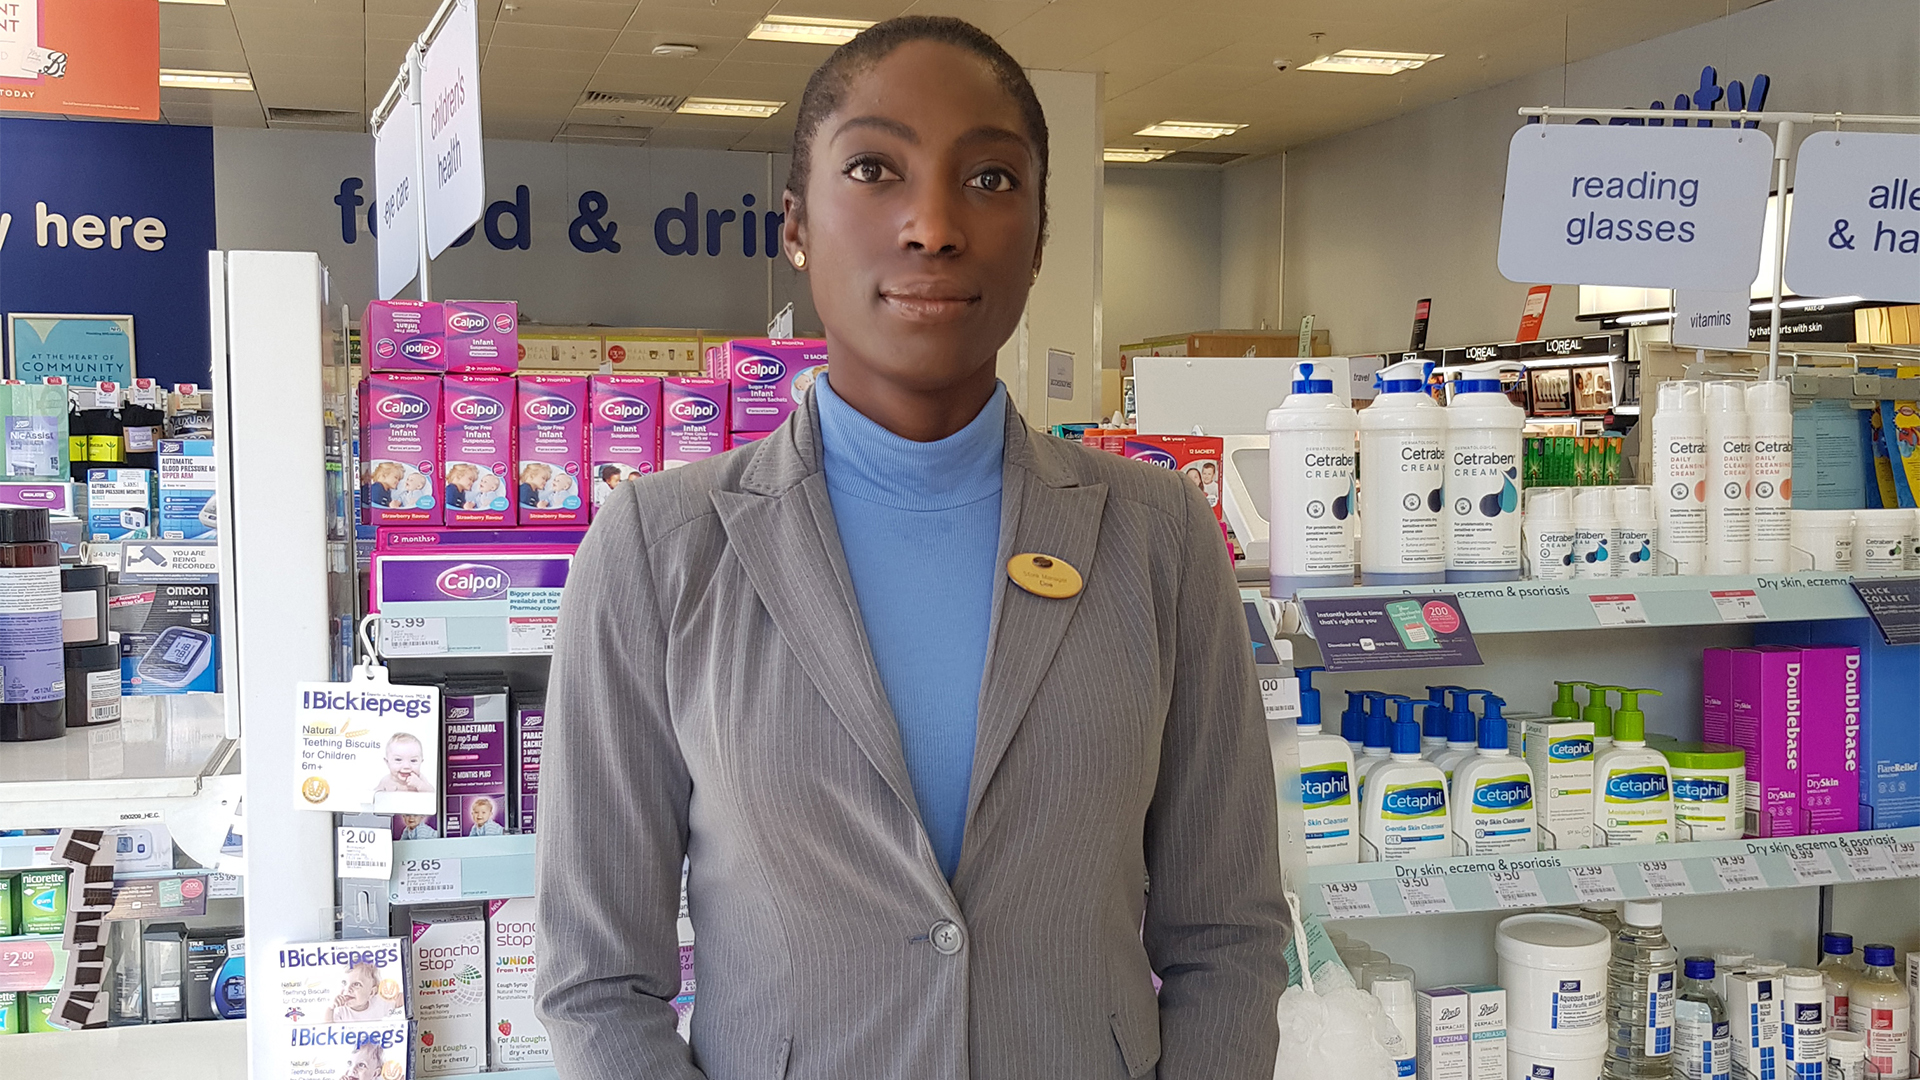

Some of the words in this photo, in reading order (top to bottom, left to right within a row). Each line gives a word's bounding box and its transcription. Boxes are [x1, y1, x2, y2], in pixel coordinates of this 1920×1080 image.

[430, 68, 466, 141] children's
[437, 133, 462, 190] health
[1571, 171, 1699, 208] reading
[383, 193, 395, 230] eye
[395, 176, 410, 207] care
[334, 177, 531, 251] fd
[568, 190, 622, 254] &
[654, 191, 785, 258] dri
[35, 201, 167, 251] here
[1565, 211, 1696, 246] glasses
[1828, 219, 1855, 250] &
[453, 317, 486, 329] Calpol
[1690, 310, 1731, 329] vitamins
[1757, 326, 1771, 337] that
[1793, 324, 1807, 334] with
[1808, 323, 1823, 333] skin
[405, 344, 437, 356] Calpol
[1546, 339, 1581, 353] L'ORÉAL
[1465, 347, 1497, 359] L'ORÉAL
[22, 361, 125, 373] COMMUNITY
[741, 363, 780, 378] Calpol
[1353, 373, 1370, 383] travel
[382, 401, 423, 416] Calpol
[457, 403, 497, 417] Calpol
[530, 403, 569, 418] Calpol
[605, 404, 643, 418] Calpol
[675, 404, 713, 418] Calpol
[391, 429, 417, 437] Infant
[613, 425, 637, 433] Infant
[1453, 452, 1515, 466] Cetraben
[1305, 470, 1346, 479] CREAM
[1401, 464, 1440, 472] CREAM
[1454, 468, 1498, 477] CREAM
[401, 535, 436, 543] months+
[444, 573, 502, 593] Calpol
[1756, 577, 1778, 590] Dry
[1780, 576, 1806, 588] skin,
[1806, 578, 1848, 588] eczema
[166, 586, 209, 596] OMRON
[509, 590, 531, 599] Bigger
[532, 590, 547, 599] pack
[1457, 586, 1503, 599] eczema
[1506, 585, 1516, 597] &
[1519, 583, 1570, 599] psoriasis
[1859, 586, 1891, 597] CLICK
[1864, 594, 1911, 604] COLLECT
[1316, 611, 1345, 619] Instantly
[1428, 606, 1449, 617] 200
[1338, 618, 1354, 627] right
[313, 690, 432, 718] Bickiepegs
[1786, 662, 1801, 771] Doublebase
[1845, 654, 1860, 772] Doublebase
[302, 724, 337, 735] Natural
[448, 724, 497, 733] PARACETAMOL
[303, 737, 343, 750] Teething
[345, 738, 381, 749] Biscuits
[448, 742, 459, 750] Oral
[459, 741, 489, 751] Suspension
[1551, 740, 1592, 757] Cetaphil
[302, 750, 313, 759] for
[316, 751, 358, 761] Children
[302, 761, 323, 771] 6m+
[1877, 762, 1919, 773] FlareRelief
[479, 770, 491, 778] PLUS
[1300, 775, 1348, 798] etaphil
[1609, 775, 1666, 795] Cetaphil
[1806, 778, 1839, 790] DrySkin
[1386, 791, 1443, 810] Cetaphil
[1476, 786, 1530, 804] Cetaphil
[1767, 790, 1796, 801] DrySkin
[1680, 804, 1701, 812] Cream
[1421, 823, 1445, 831] Cleanser
[1475, 819, 1488, 827] Oily
[1489, 818, 1502, 826] Skin
[1502, 817, 1525, 825] Cleanser
[341, 829, 376, 844] £2.00
[1746, 843, 1768, 856] Dry
[1769, 841, 1794, 855] skin,
[1795, 839, 1837, 851] eczema
[1838, 836, 1848, 847] &
[1850, 834, 1897, 850] psoriasis
[1395, 865, 1418, 879] Dry
[1420, 863, 1448, 876] skin,
[1449, 862, 1496, 874] eczema
[1498, 858, 1508, 871] &
[1509, 855, 1562, 873] psoriasis
[22, 873, 65, 884] nicorette
[36, 898, 52, 906] gum
[496, 934, 533, 948] stop
[288, 946, 399, 970] Bickiepegs
[419, 944, 480, 959] broncho
[3, 951, 35, 968] £2.00
[419, 958, 454, 971] stop
[299, 1026, 405, 1050] Bickiepegs
[497, 1036, 510, 1044] For
[510, 1035, 520, 1043] All
[520, 1034, 547, 1045] Coughs
[1438, 1034, 1464, 1043] ECZEMA
[1474, 1030, 1505, 1040] PSORIASIS
[442, 1043, 468, 1053] Coughs
